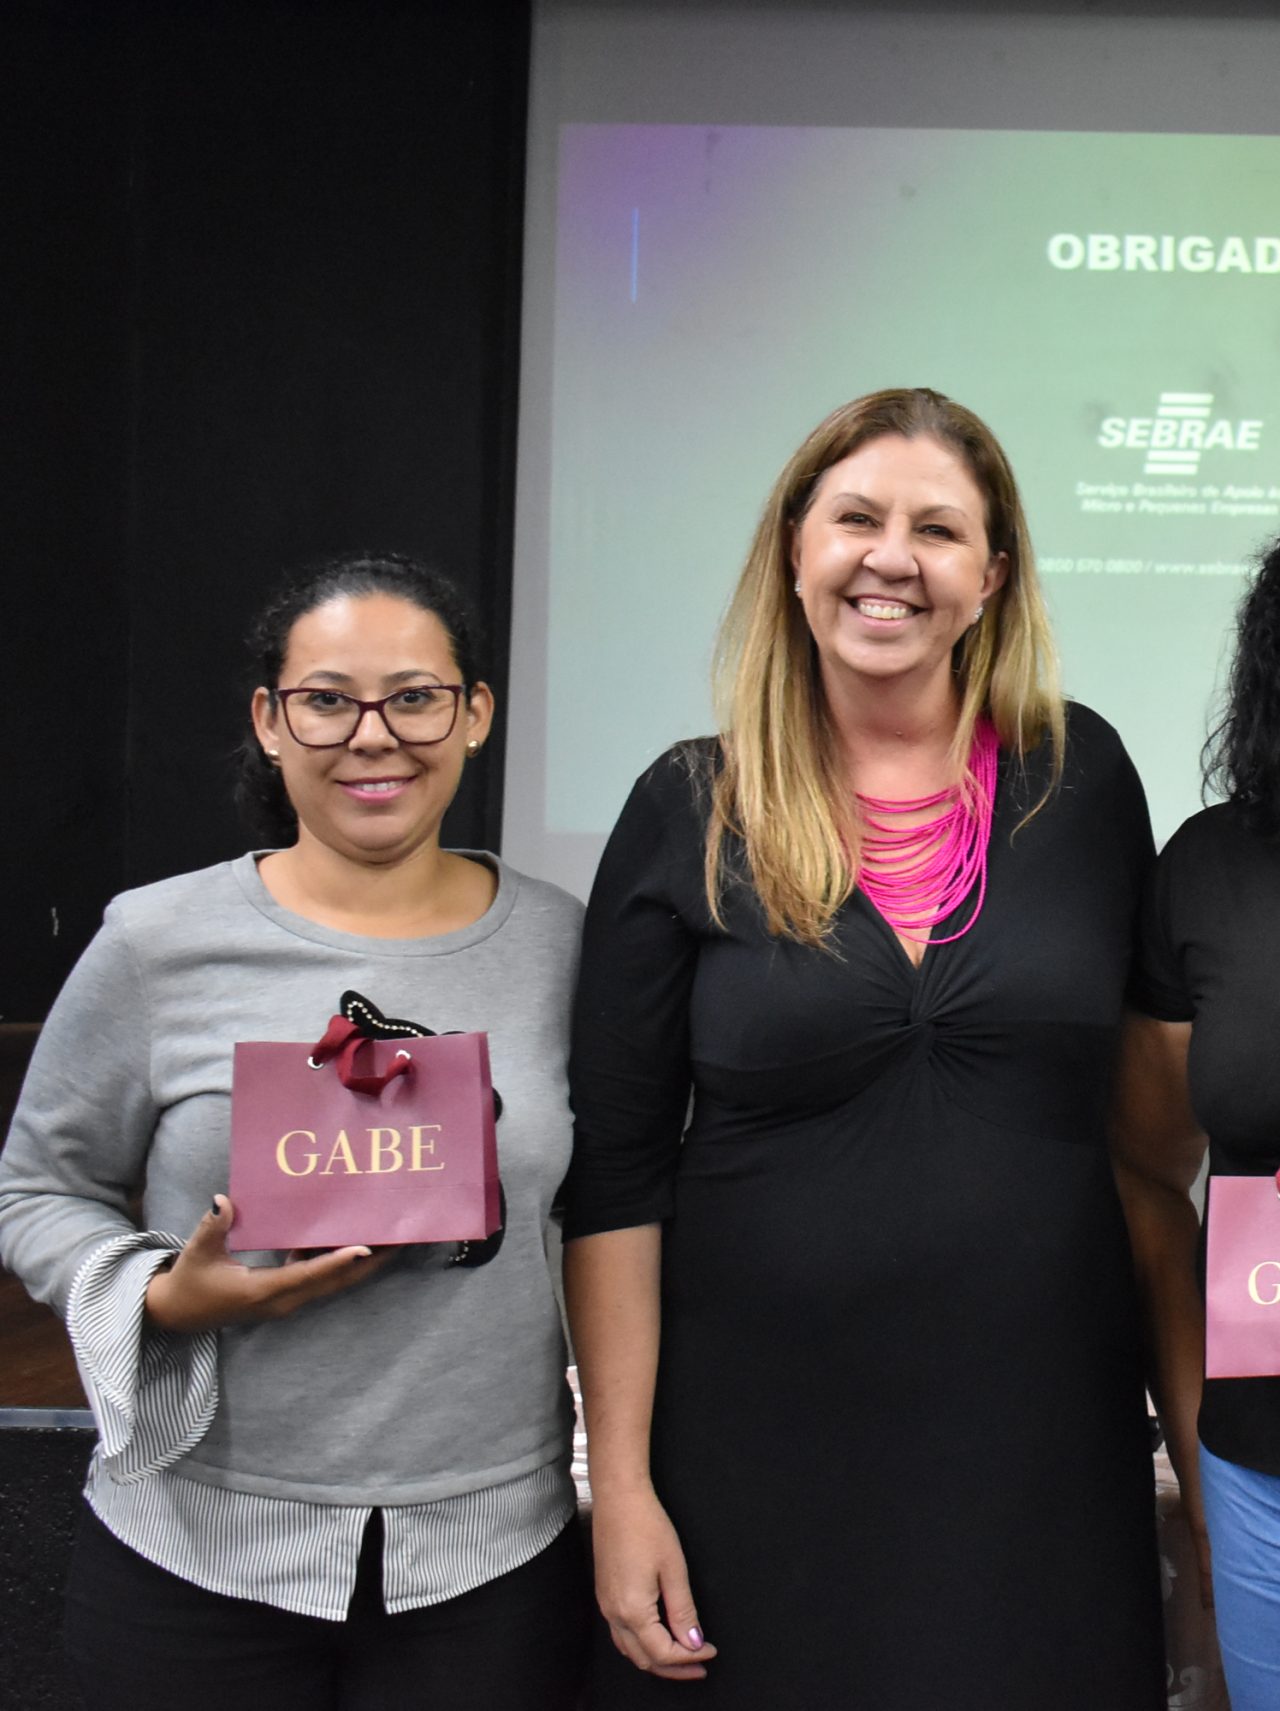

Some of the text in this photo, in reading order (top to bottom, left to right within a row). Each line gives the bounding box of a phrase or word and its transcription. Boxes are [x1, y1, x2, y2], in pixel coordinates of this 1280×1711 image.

[1099, 417, 1263, 450] SEBRAE
[1132, 483, 1197, 498] Brasileiro
[1201, 485, 1220, 497] de
[1223, 485, 1265, 499] Apoio
[1081, 499, 1279, 515] Micro e Pequenas Empresas
[1105, 558, 1143, 574] 0800
[275, 1124, 445, 1177] GABE
